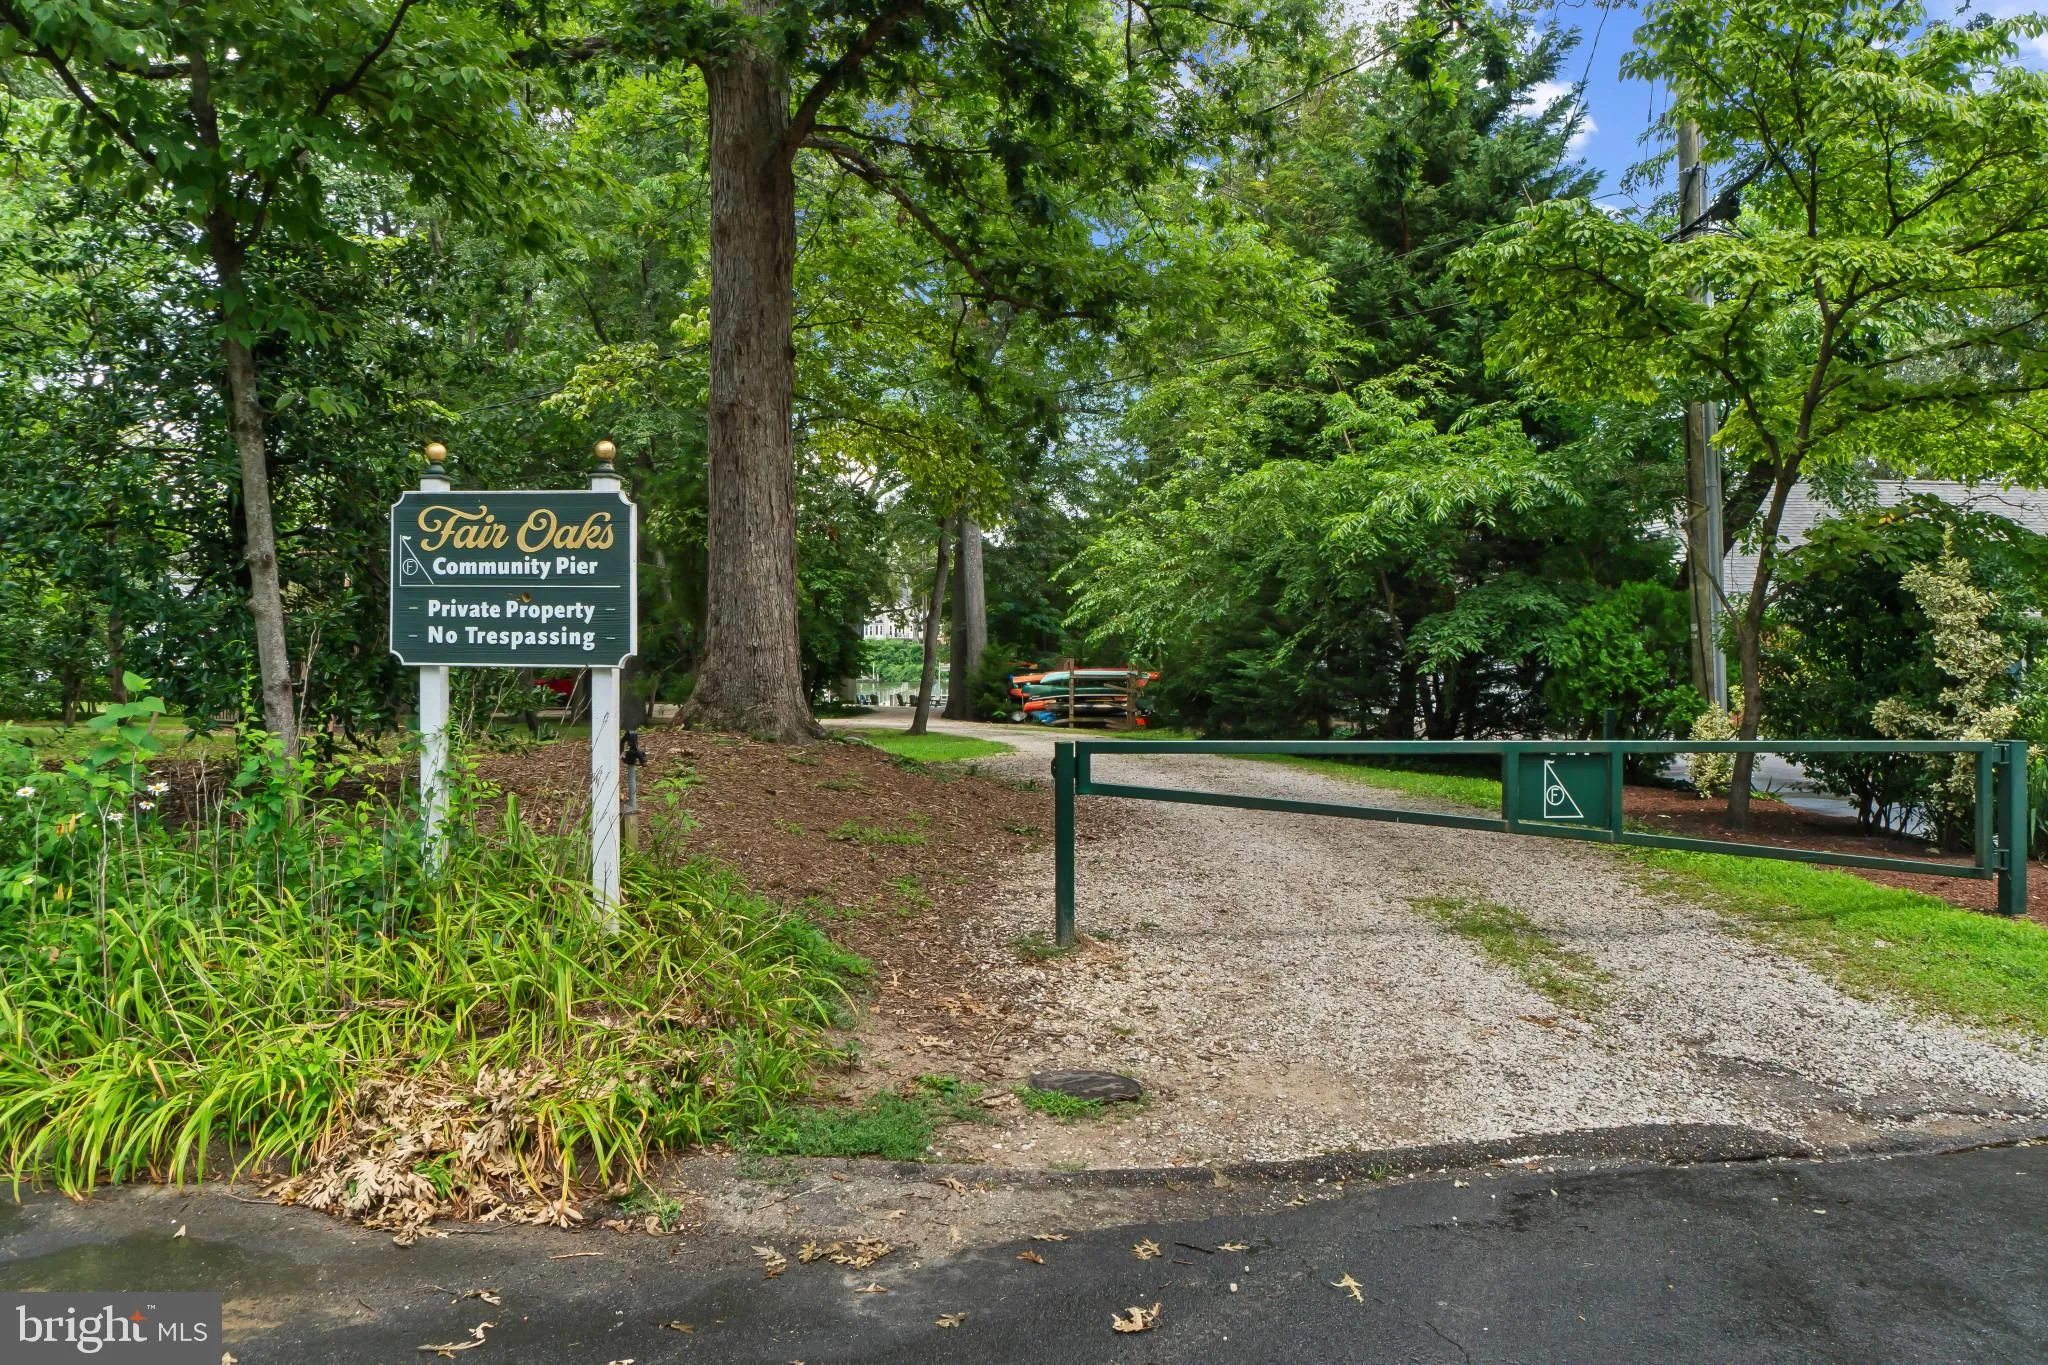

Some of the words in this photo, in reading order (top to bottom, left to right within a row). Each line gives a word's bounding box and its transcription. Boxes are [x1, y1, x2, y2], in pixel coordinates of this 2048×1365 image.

[417, 505, 509, 552] Fair
[516, 508, 614, 553] Oaks
[432, 555, 551, 579] Community
[556, 556, 598, 575] Pier
[428, 599, 500, 618] Private
[506, 600, 595, 624] Property
[428, 626, 458, 644] No
[464, 626, 595, 651] Trespassing
